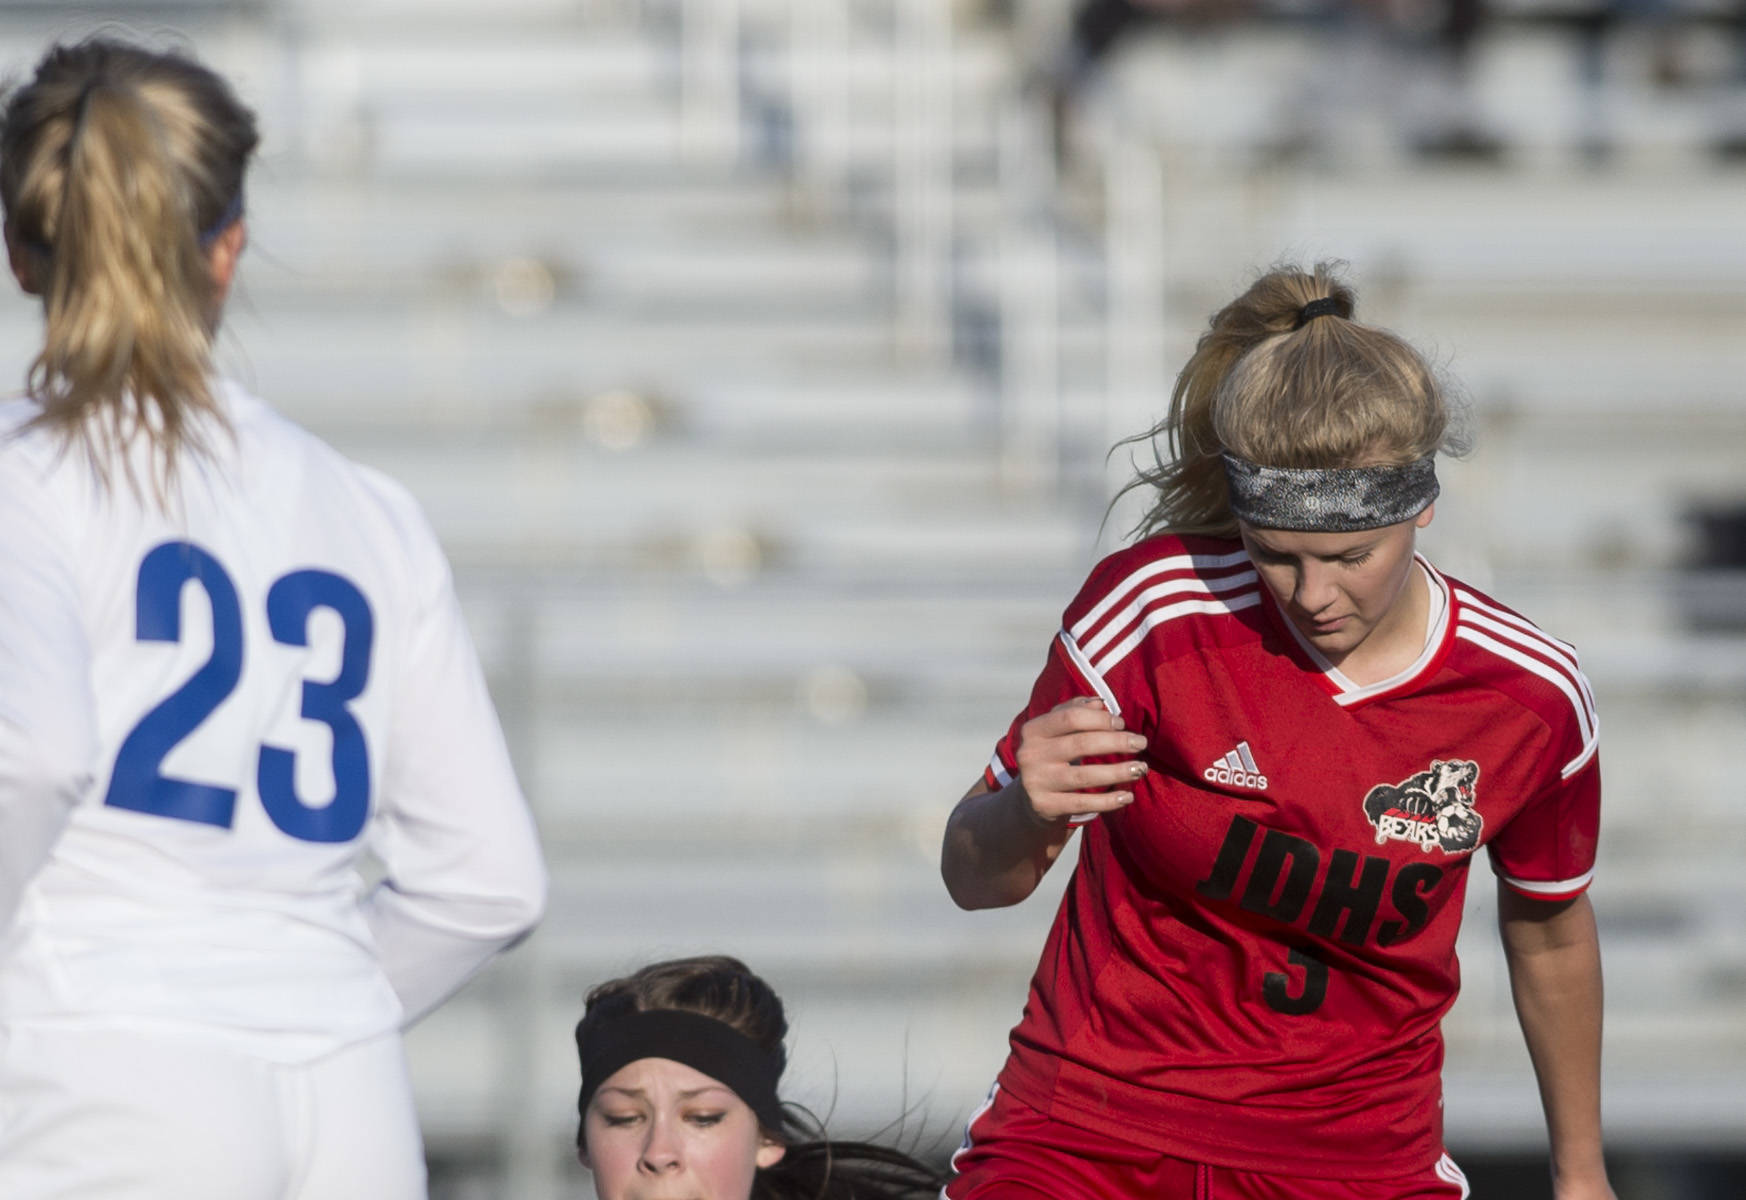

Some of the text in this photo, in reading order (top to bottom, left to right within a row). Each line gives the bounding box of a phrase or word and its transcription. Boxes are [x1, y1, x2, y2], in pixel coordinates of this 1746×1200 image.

[103, 540, 374, 843] 23
[1204, 767, 1268, 790] adidas
[1378, 814, 1440, 847] BEARS
[1196, 814, 1443, 948] JDHS
